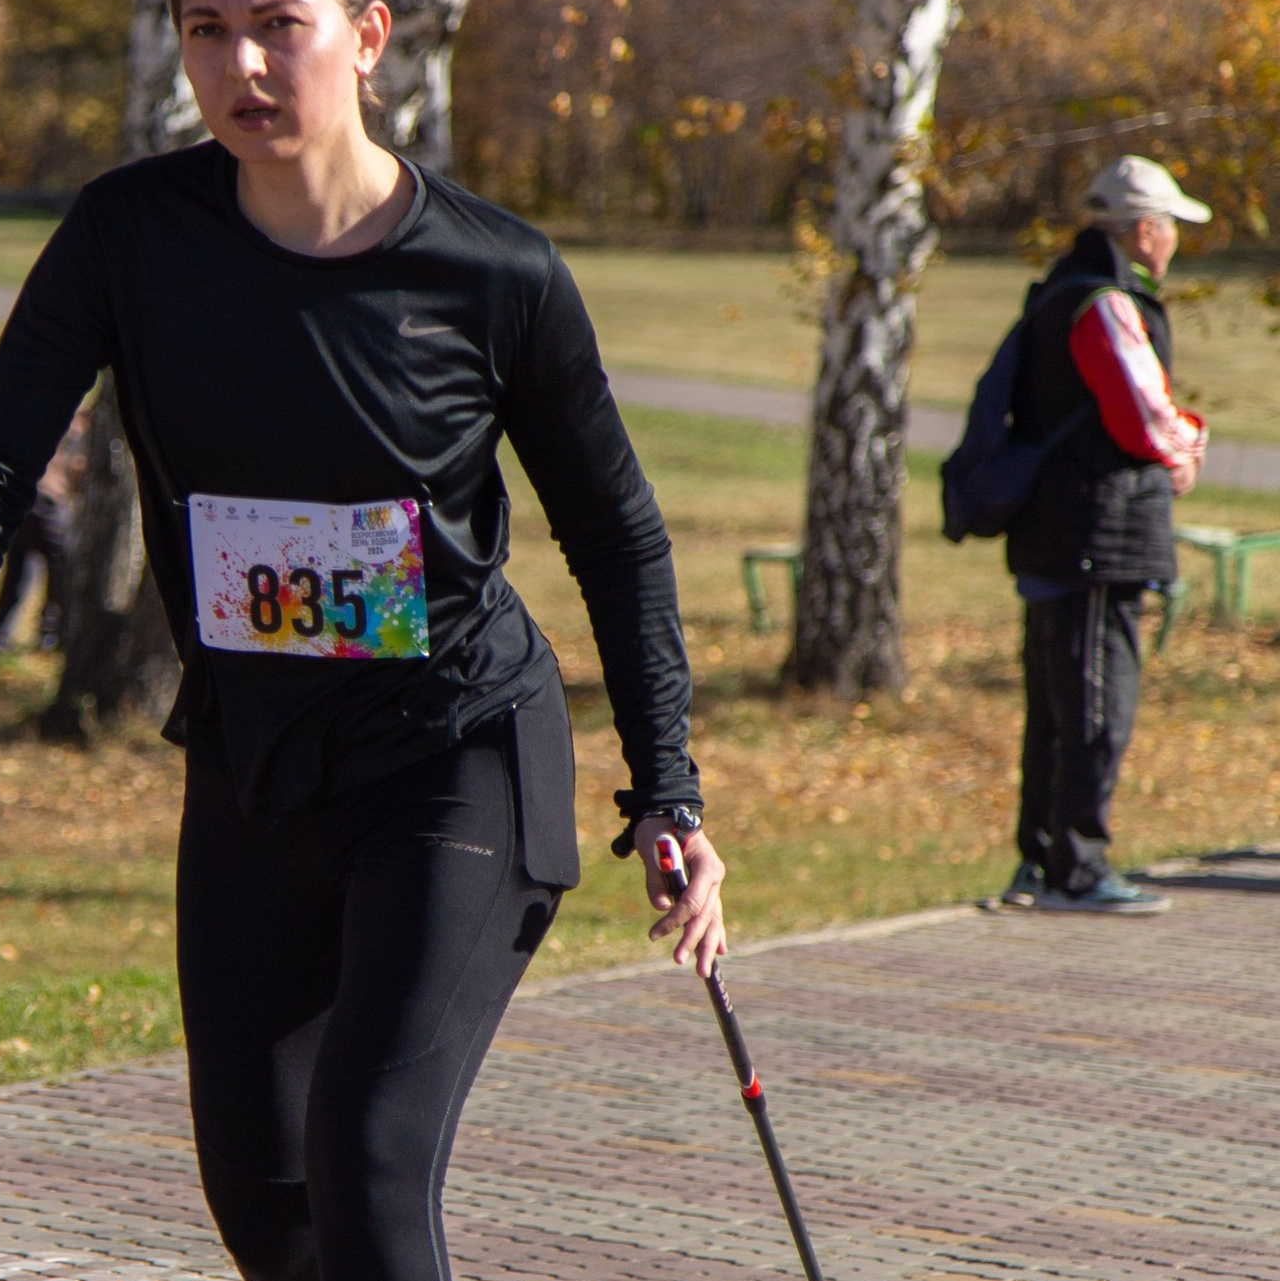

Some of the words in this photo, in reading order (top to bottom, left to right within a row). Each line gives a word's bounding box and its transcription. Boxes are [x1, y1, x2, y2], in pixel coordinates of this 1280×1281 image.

[351, 538, 369, 547] ДЕНЬ
[367, 547, 384, 556] 2024
[247, 564, 368, 640] 835
[441, 841, 495, 857] DEMIX
